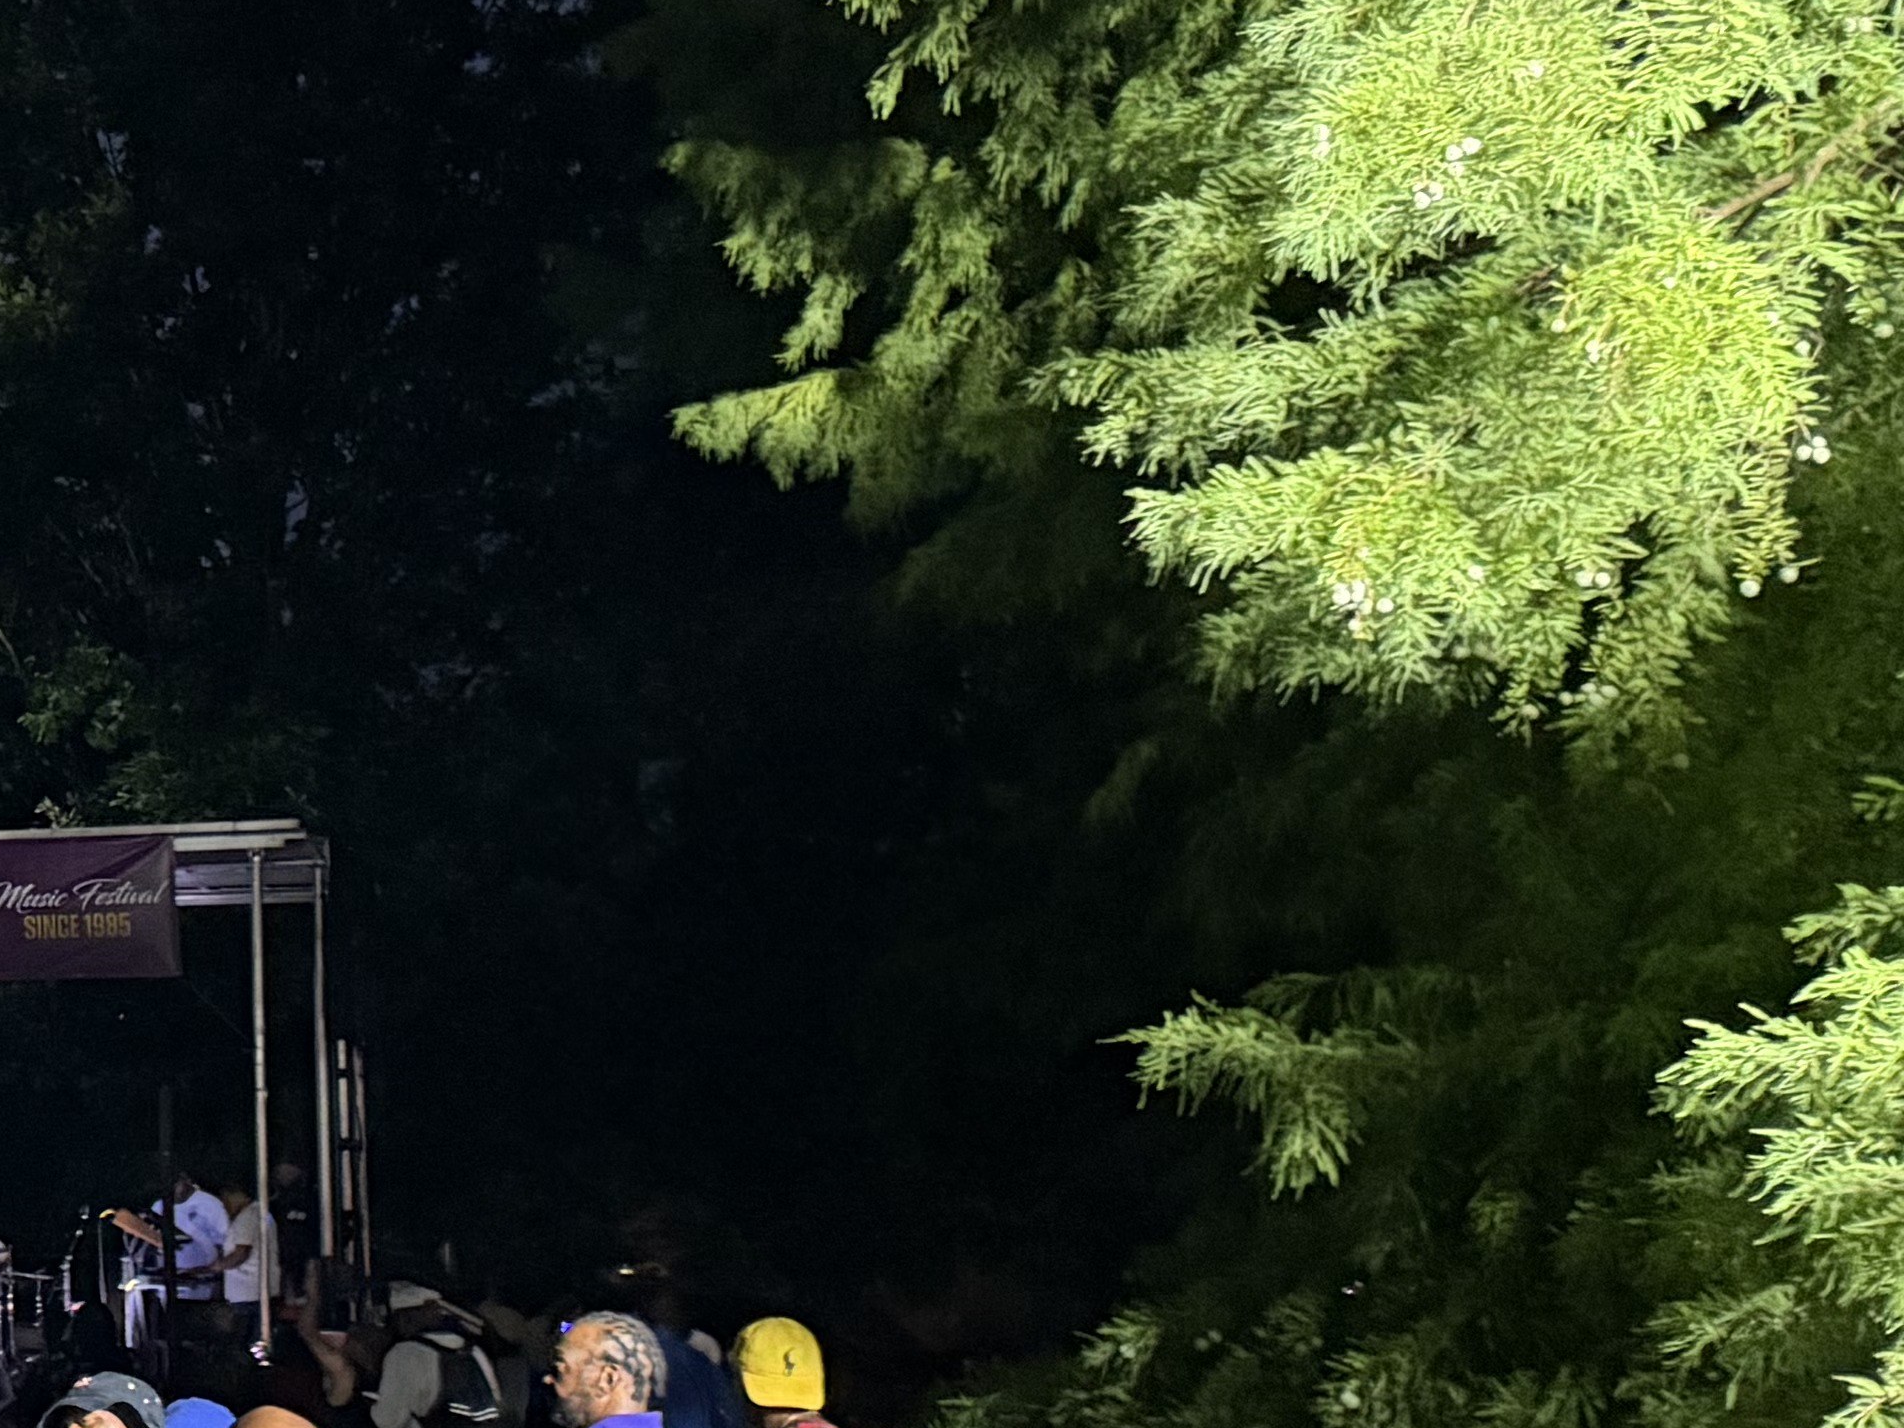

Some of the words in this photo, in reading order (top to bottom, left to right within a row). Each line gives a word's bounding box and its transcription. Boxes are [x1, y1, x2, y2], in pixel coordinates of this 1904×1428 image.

[73, 877, 167, 910] Festival
[23, 913, 80, 940] SINCE
[82, 911, 132, 938] 1985
